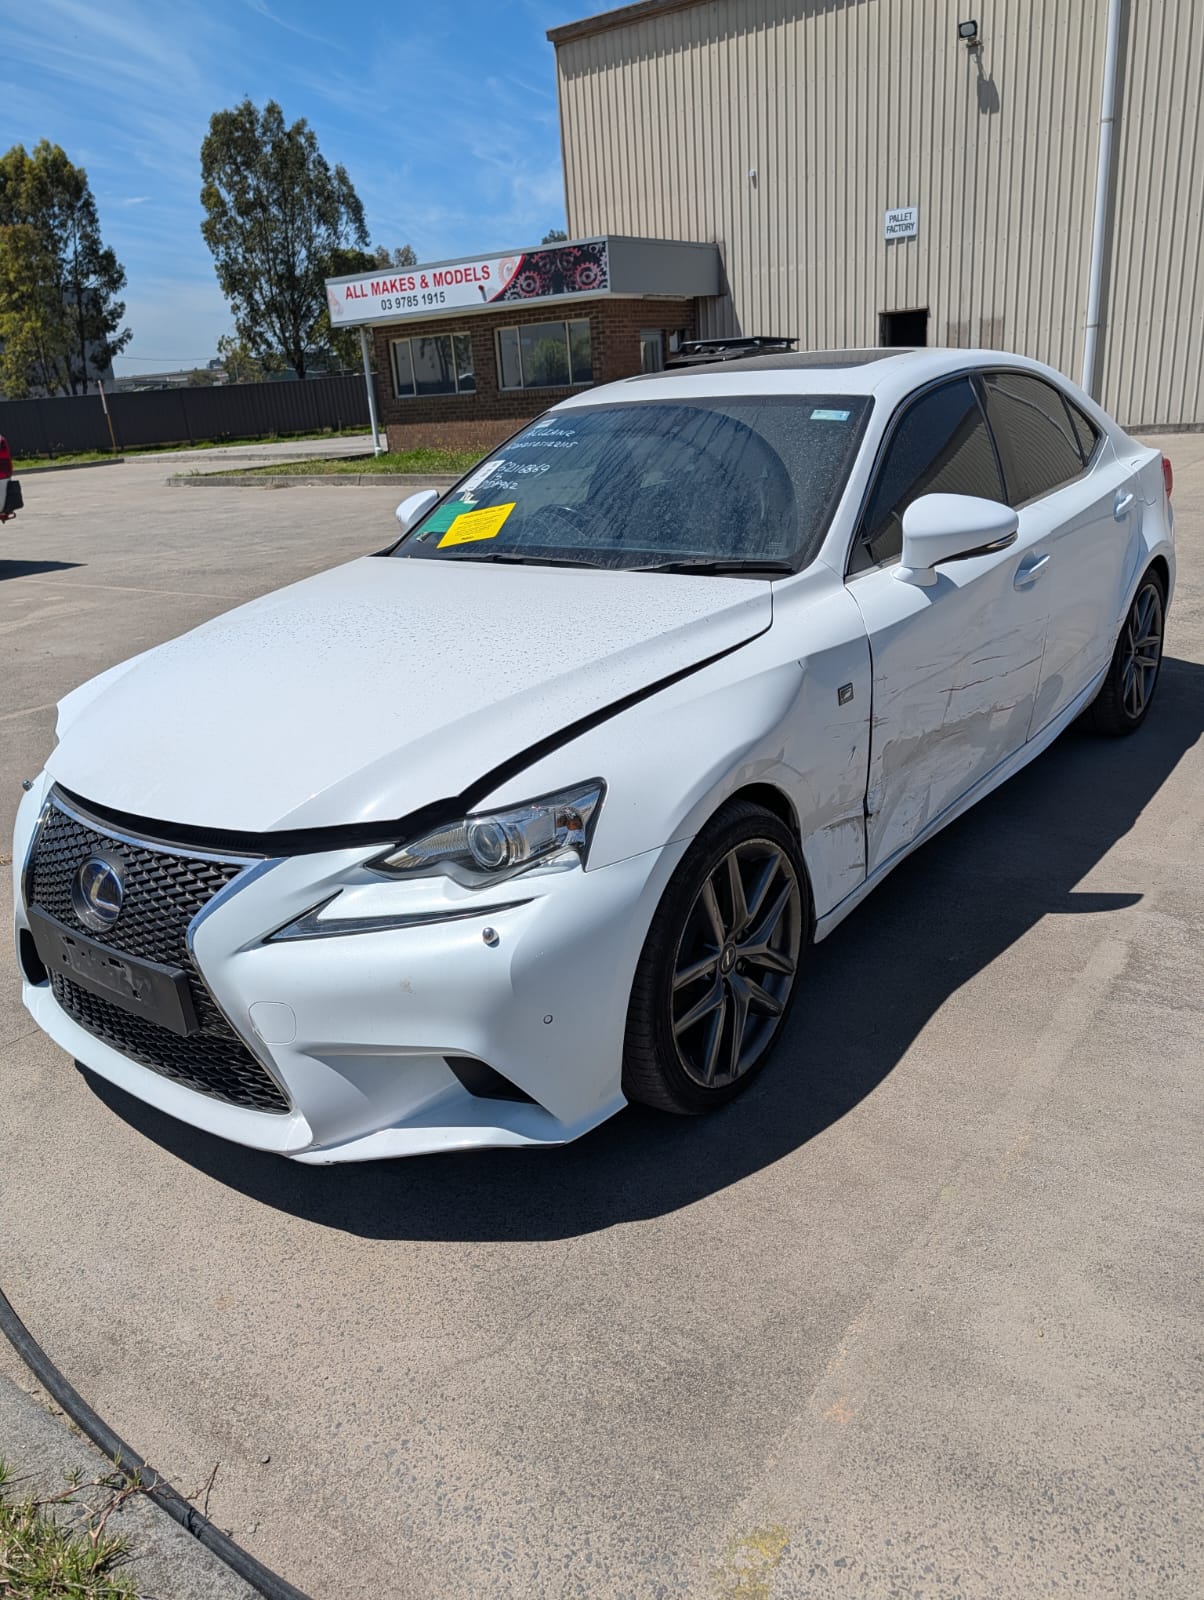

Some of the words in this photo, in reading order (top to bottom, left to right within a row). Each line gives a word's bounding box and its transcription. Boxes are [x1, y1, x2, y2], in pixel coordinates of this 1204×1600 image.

[889, 212, 912, 223] PALLET
[886, 222, 915, 234] FACTORY
[345, 284, 368, 300] ALL
[371, 276, 416, 297] MAKES
[420, 274, 430, 289] &
[433, 265, 491, 288] MODELS
[381, 298, 393, 311] 03
[395, 295, 419, 309] 9785
[421, 291, 446, 305] 1915
